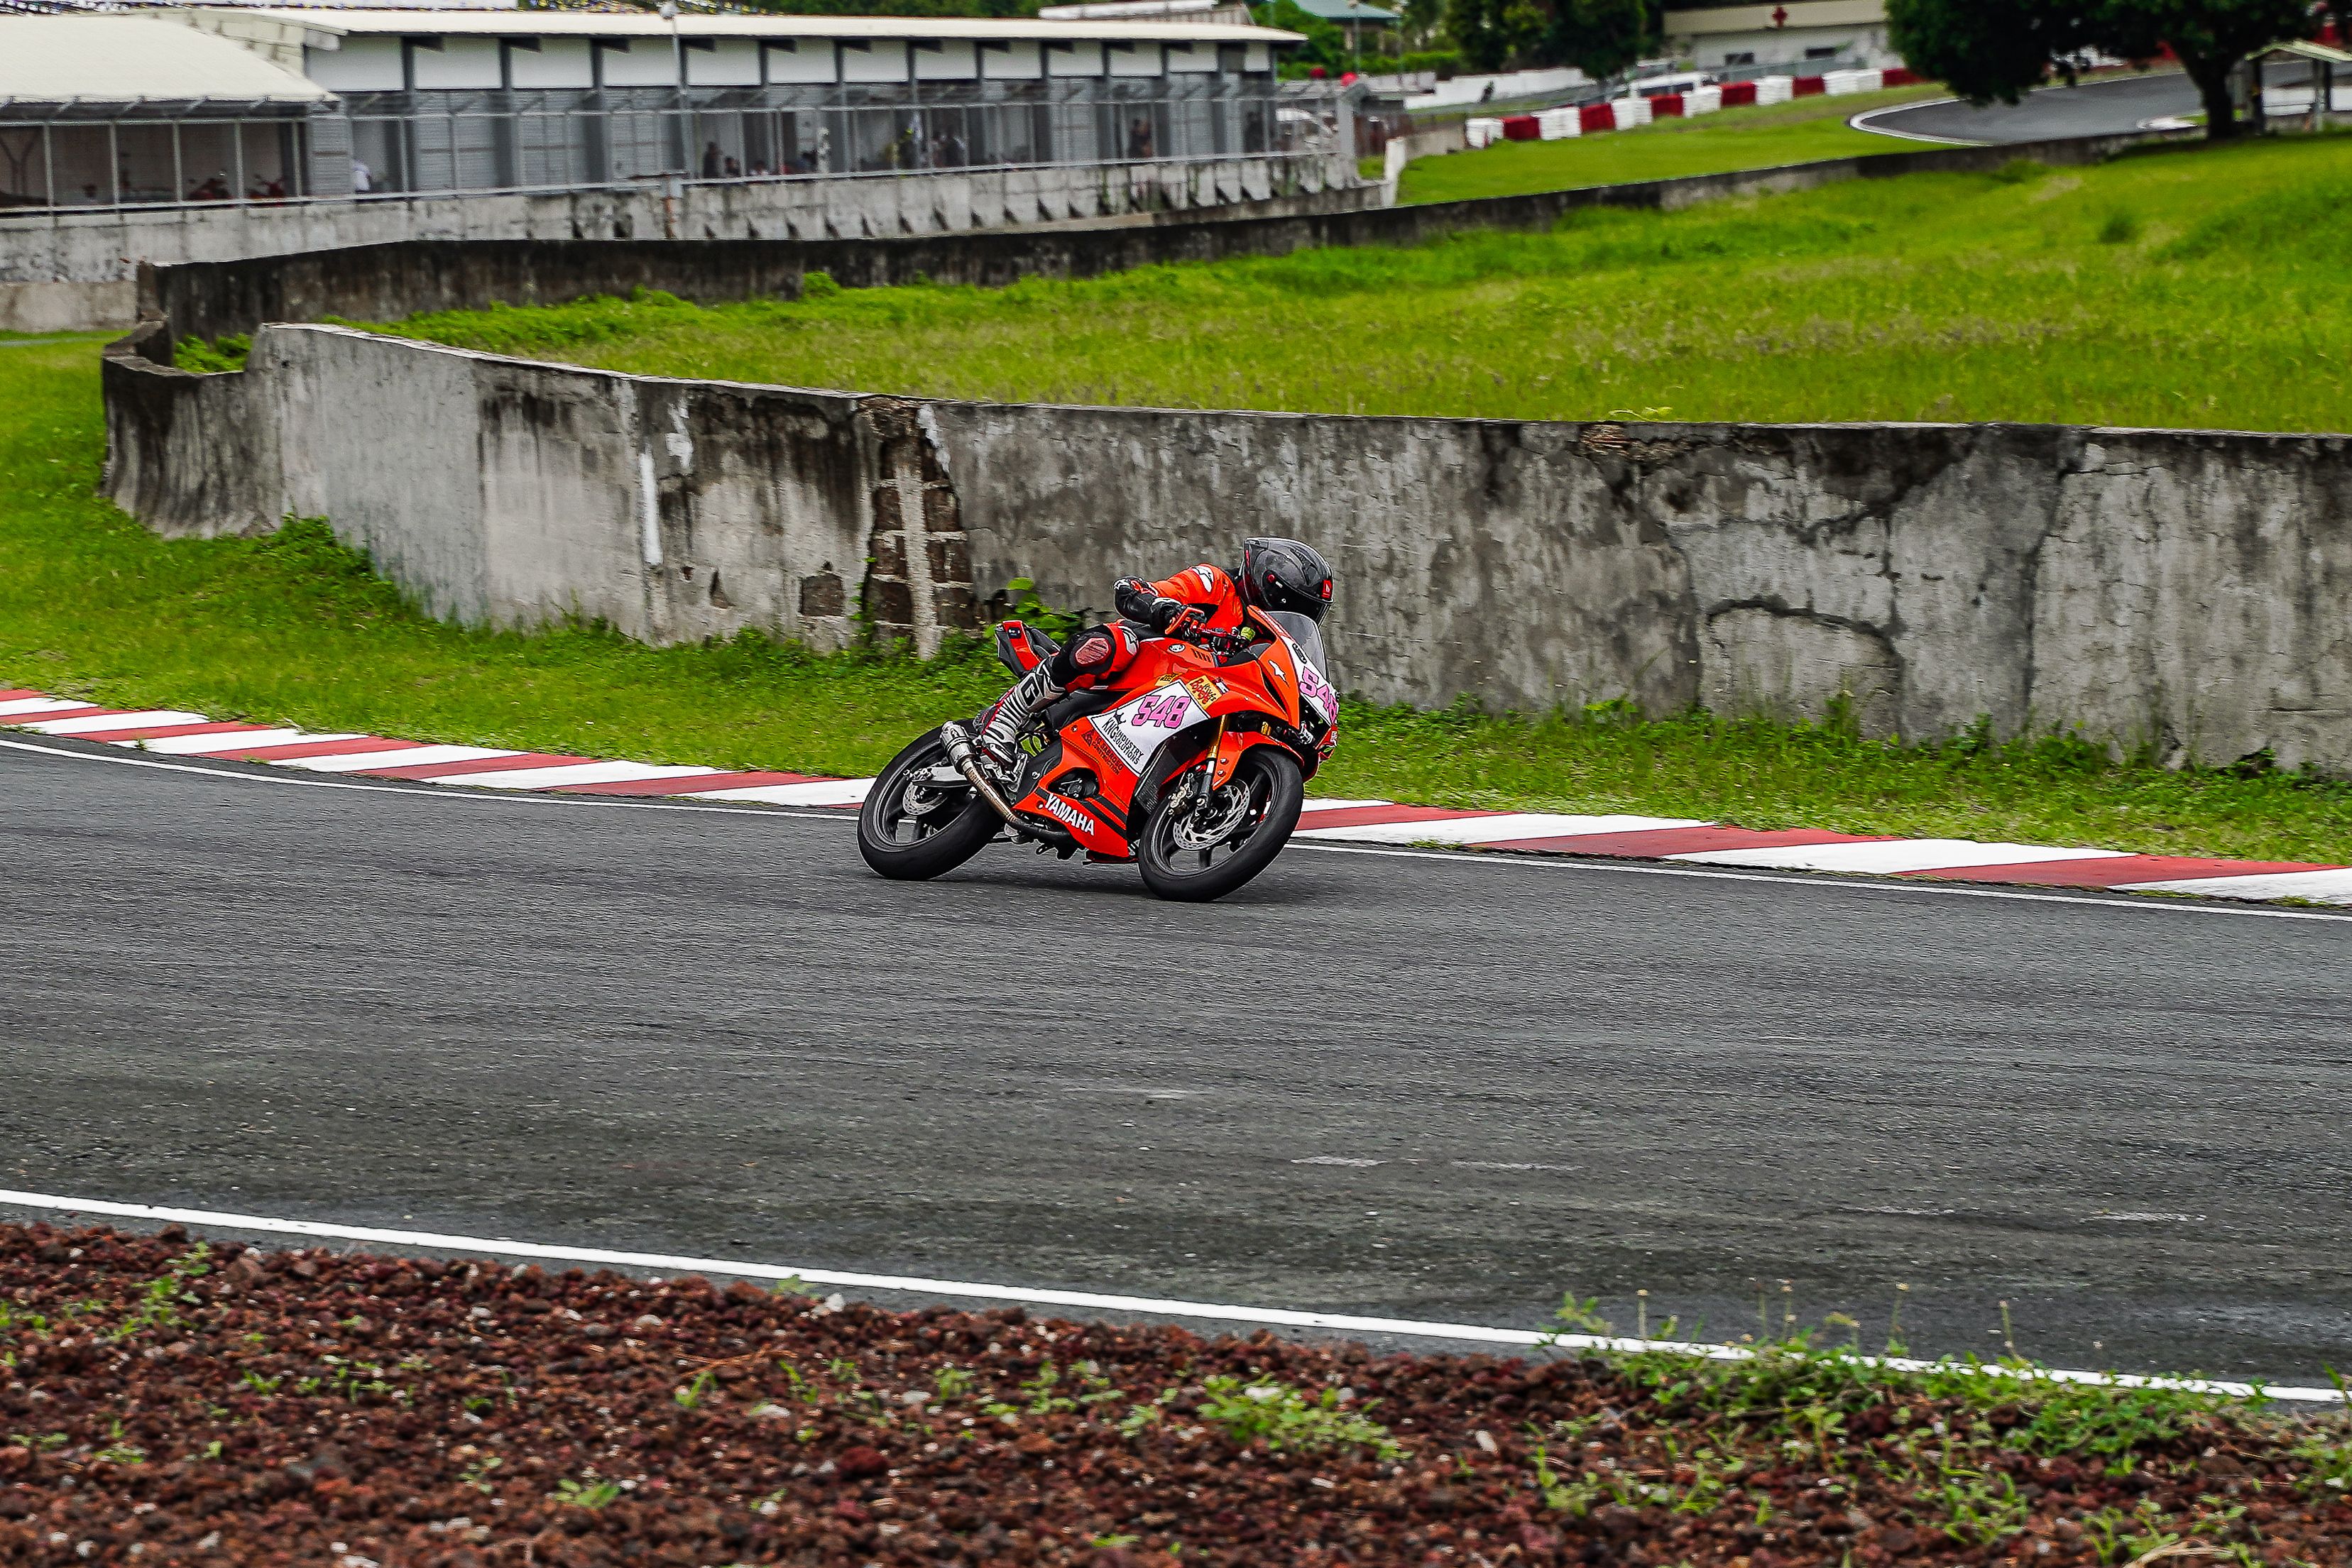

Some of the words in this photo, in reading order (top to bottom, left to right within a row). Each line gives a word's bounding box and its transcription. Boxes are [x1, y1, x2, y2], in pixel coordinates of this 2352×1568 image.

[1132, 694, 1192, 729] 548
[1102, 717, 1120, 738] KNG
[1113, 736, 1140, 764] SOLUTIONS
[1116, 729, 1144, 759] INDUSTRY
[1045, 793, 1094, 835] YAMAHA
